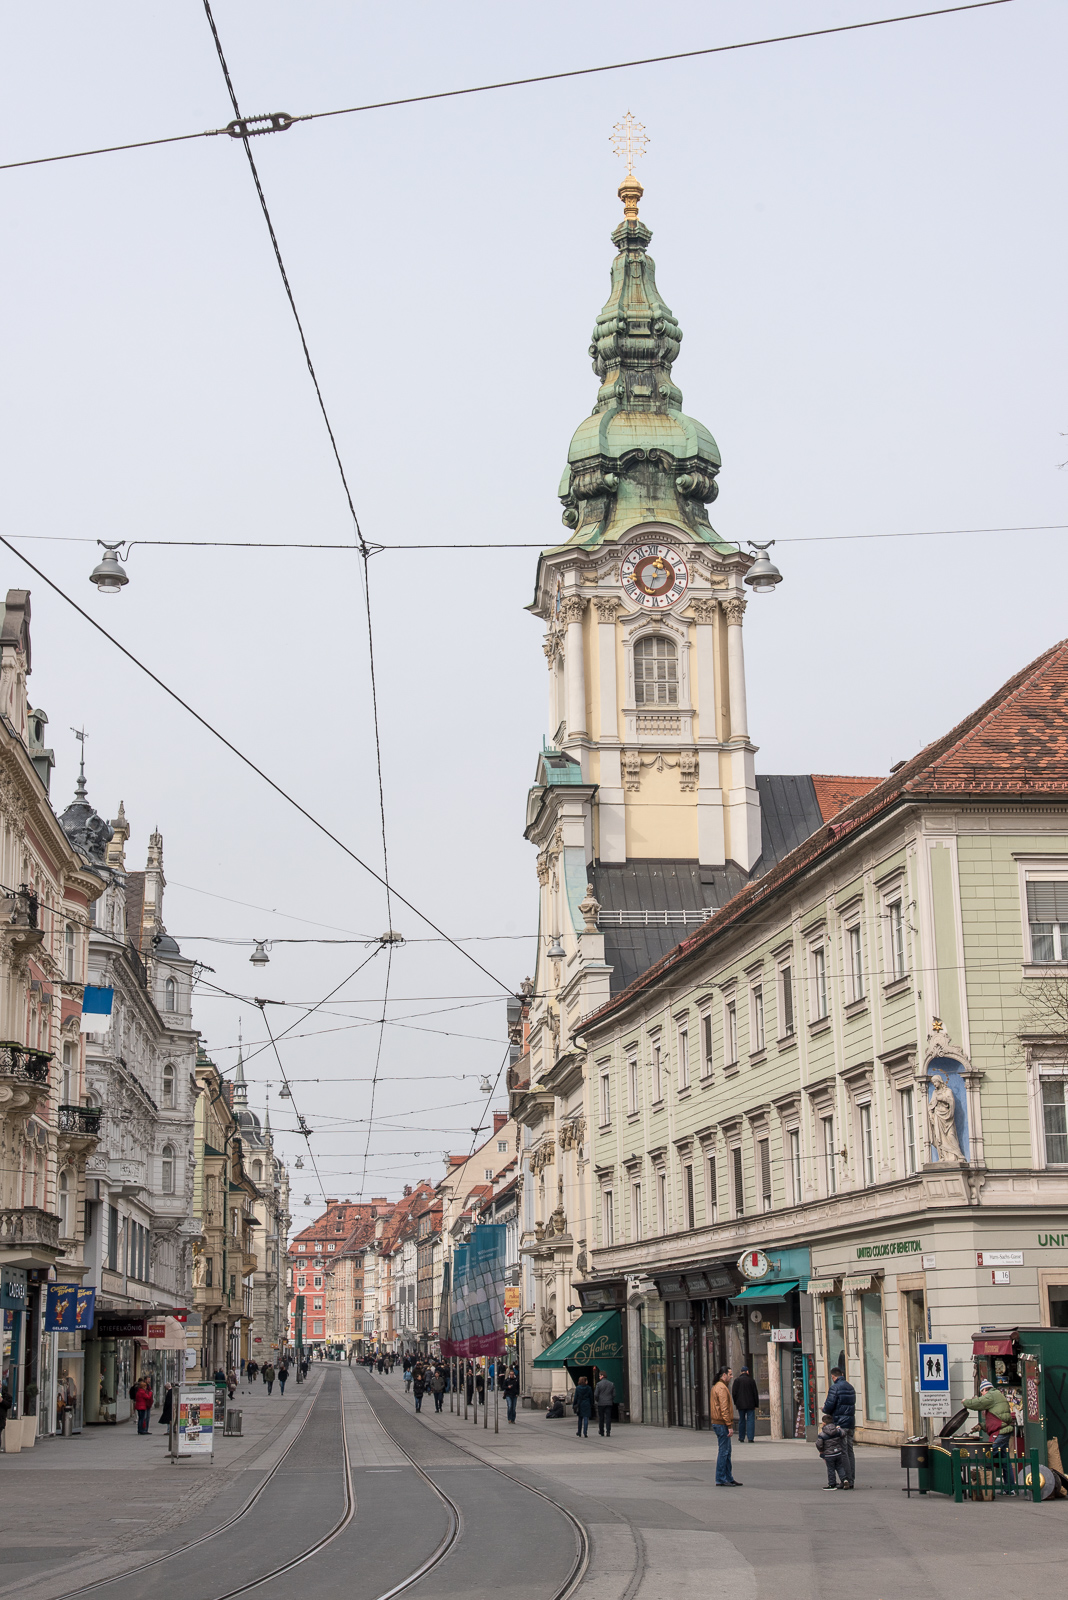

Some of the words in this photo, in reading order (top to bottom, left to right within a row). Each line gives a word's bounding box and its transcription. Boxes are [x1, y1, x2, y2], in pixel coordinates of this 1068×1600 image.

[634, 547, 646, 560] XI
[647, 545, 659, 556] XII
[664, 549, 671, 559] I
[625, 557, 636, 568] X
[672, 559, 682, 568] II
[652, 597, 659, 607] VI
[665, 594, 674, 604] V
[856, 1247, 873, 1259] UNITED
[872, 1244, 889, 1258] COLORS
[889, 1243, 897, 1255] OF
